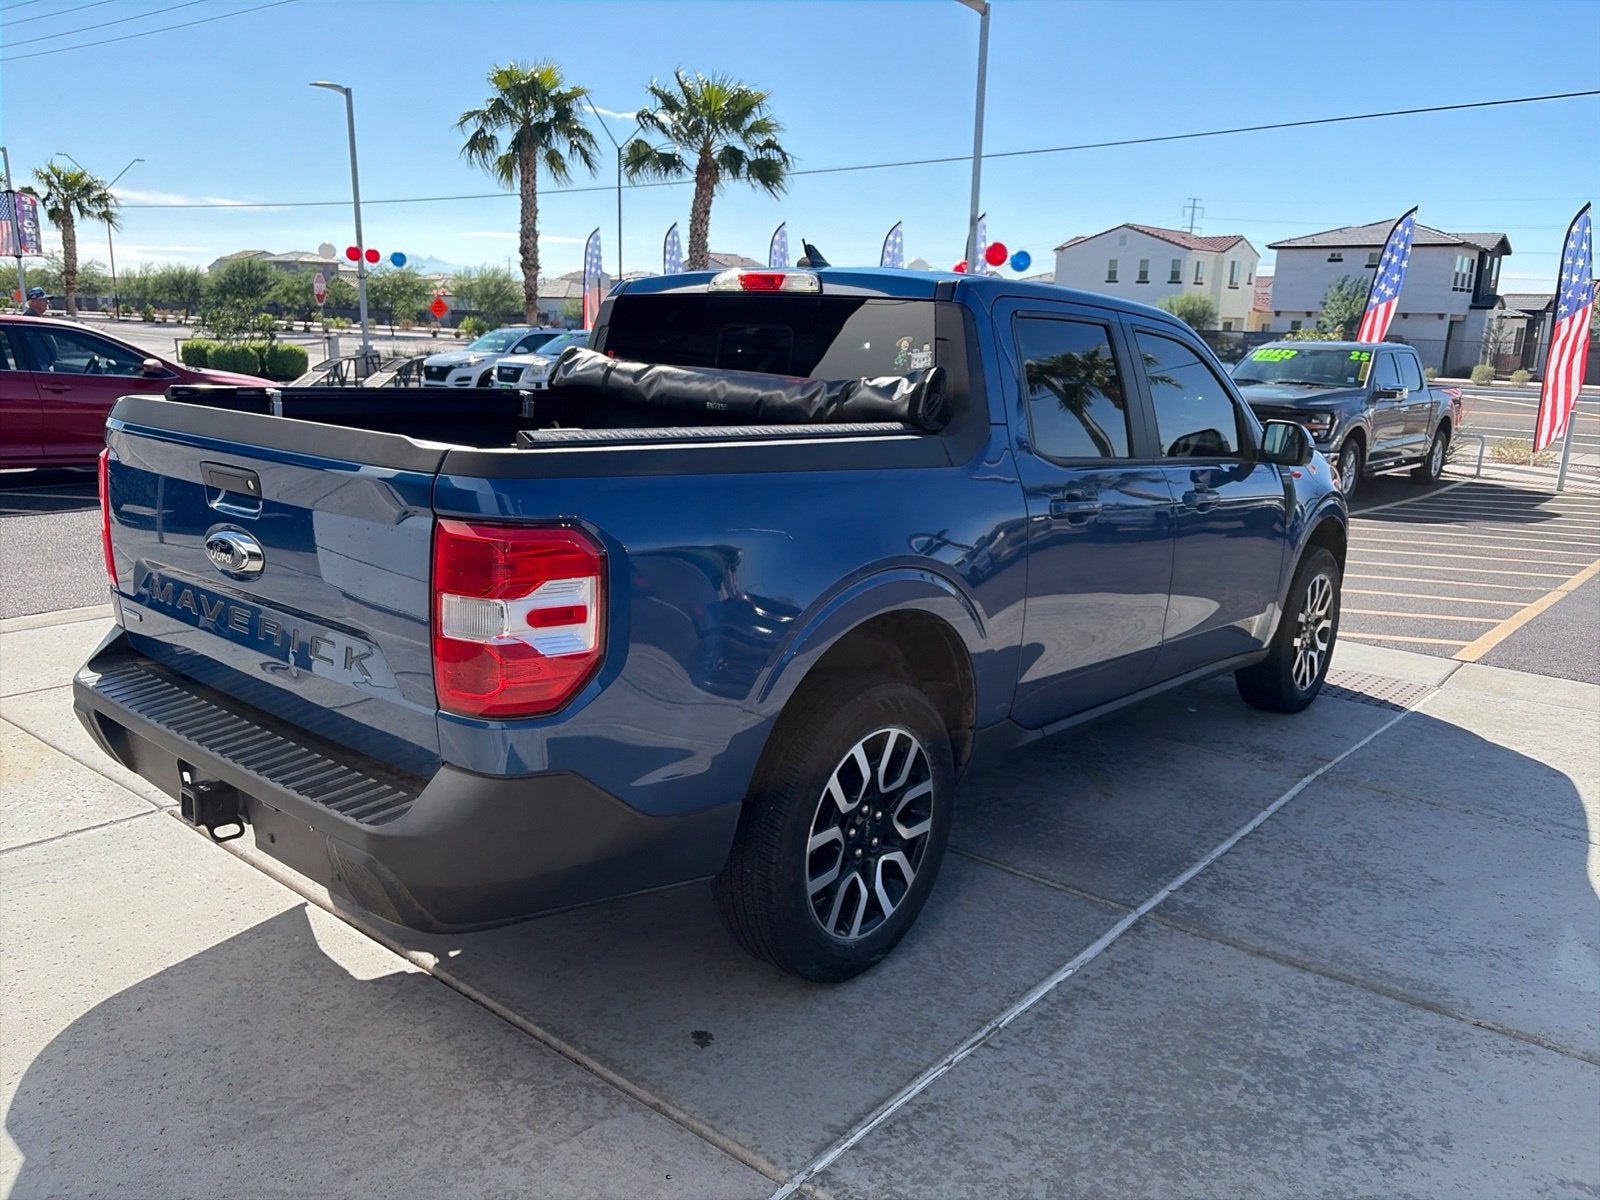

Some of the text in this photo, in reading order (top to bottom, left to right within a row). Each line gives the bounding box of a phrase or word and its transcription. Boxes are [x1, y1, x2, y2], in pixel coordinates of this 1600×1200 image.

[1349, 351, 1370, 361] 25
[210, 540, 233, 564] Ford
[151, 576, 374, 680] MAVERICK
